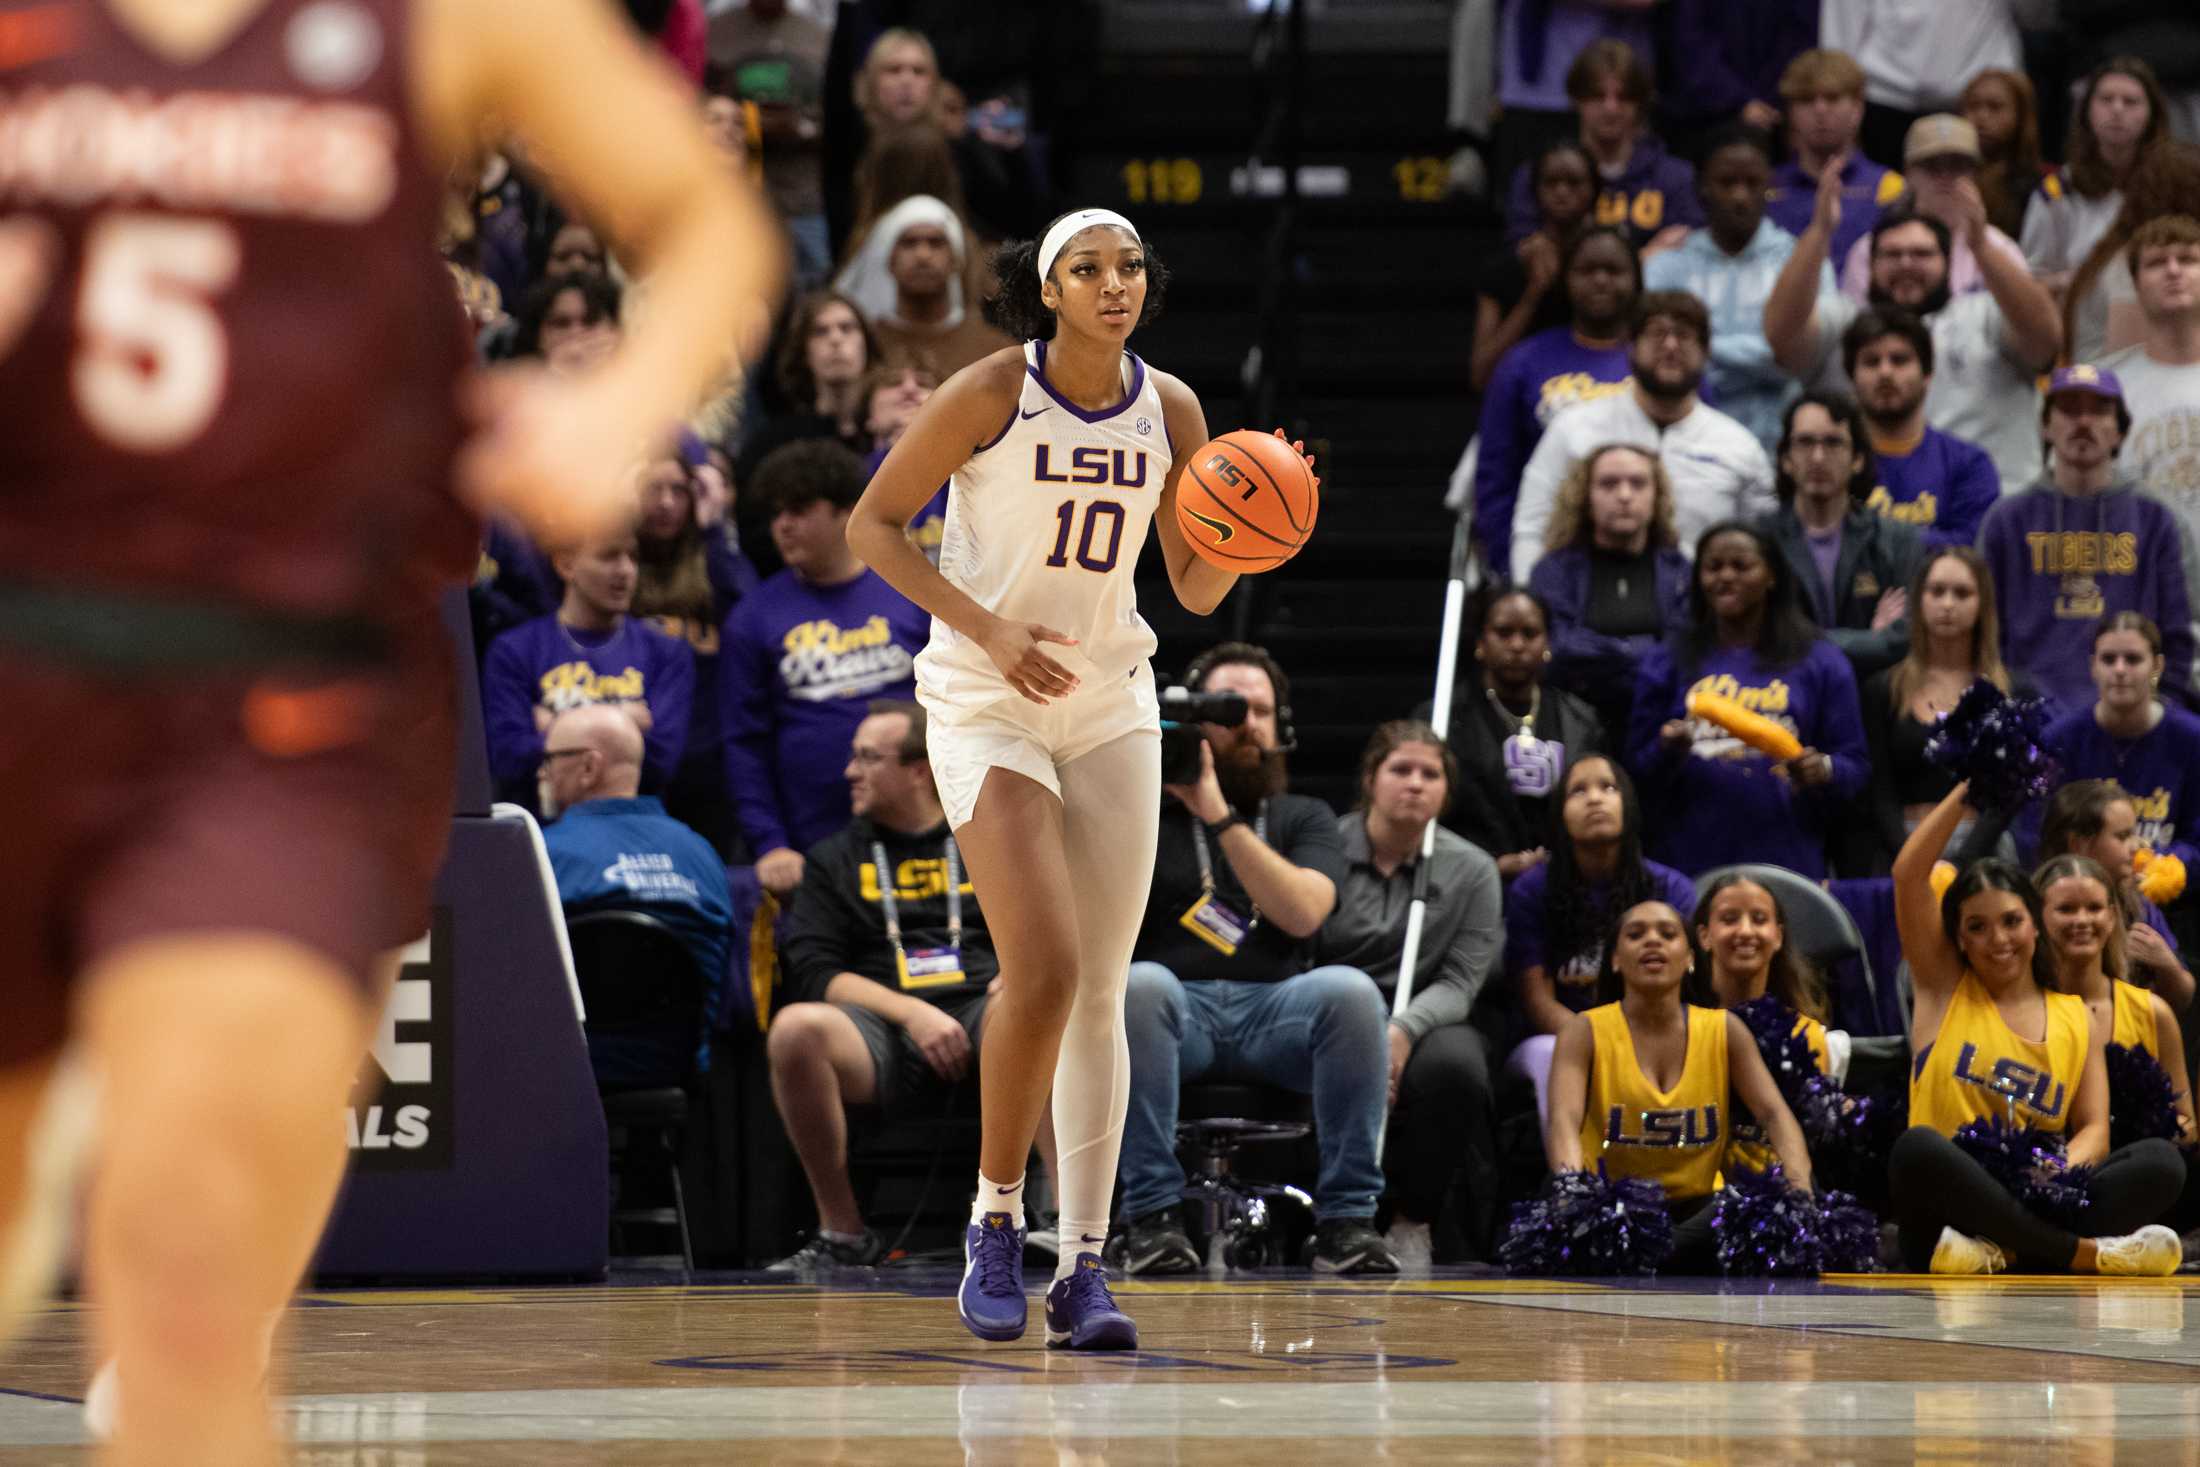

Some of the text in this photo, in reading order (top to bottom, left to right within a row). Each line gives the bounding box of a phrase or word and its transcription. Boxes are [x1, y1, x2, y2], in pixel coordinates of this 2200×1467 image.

[1125, 159, 1202, 203] 119
[78, 215, 240, 452] 5
[1035, 443, 1147, 488] LSU
[1206, 454, 1258, 501] LSU
[1046, 500, 1125, 573] 10
[2025, 531, 2138, 575] TIGERS
[1954, 1041, 2065, 1119] LSU
[1605, 1104, 1720, 1148] LSU
